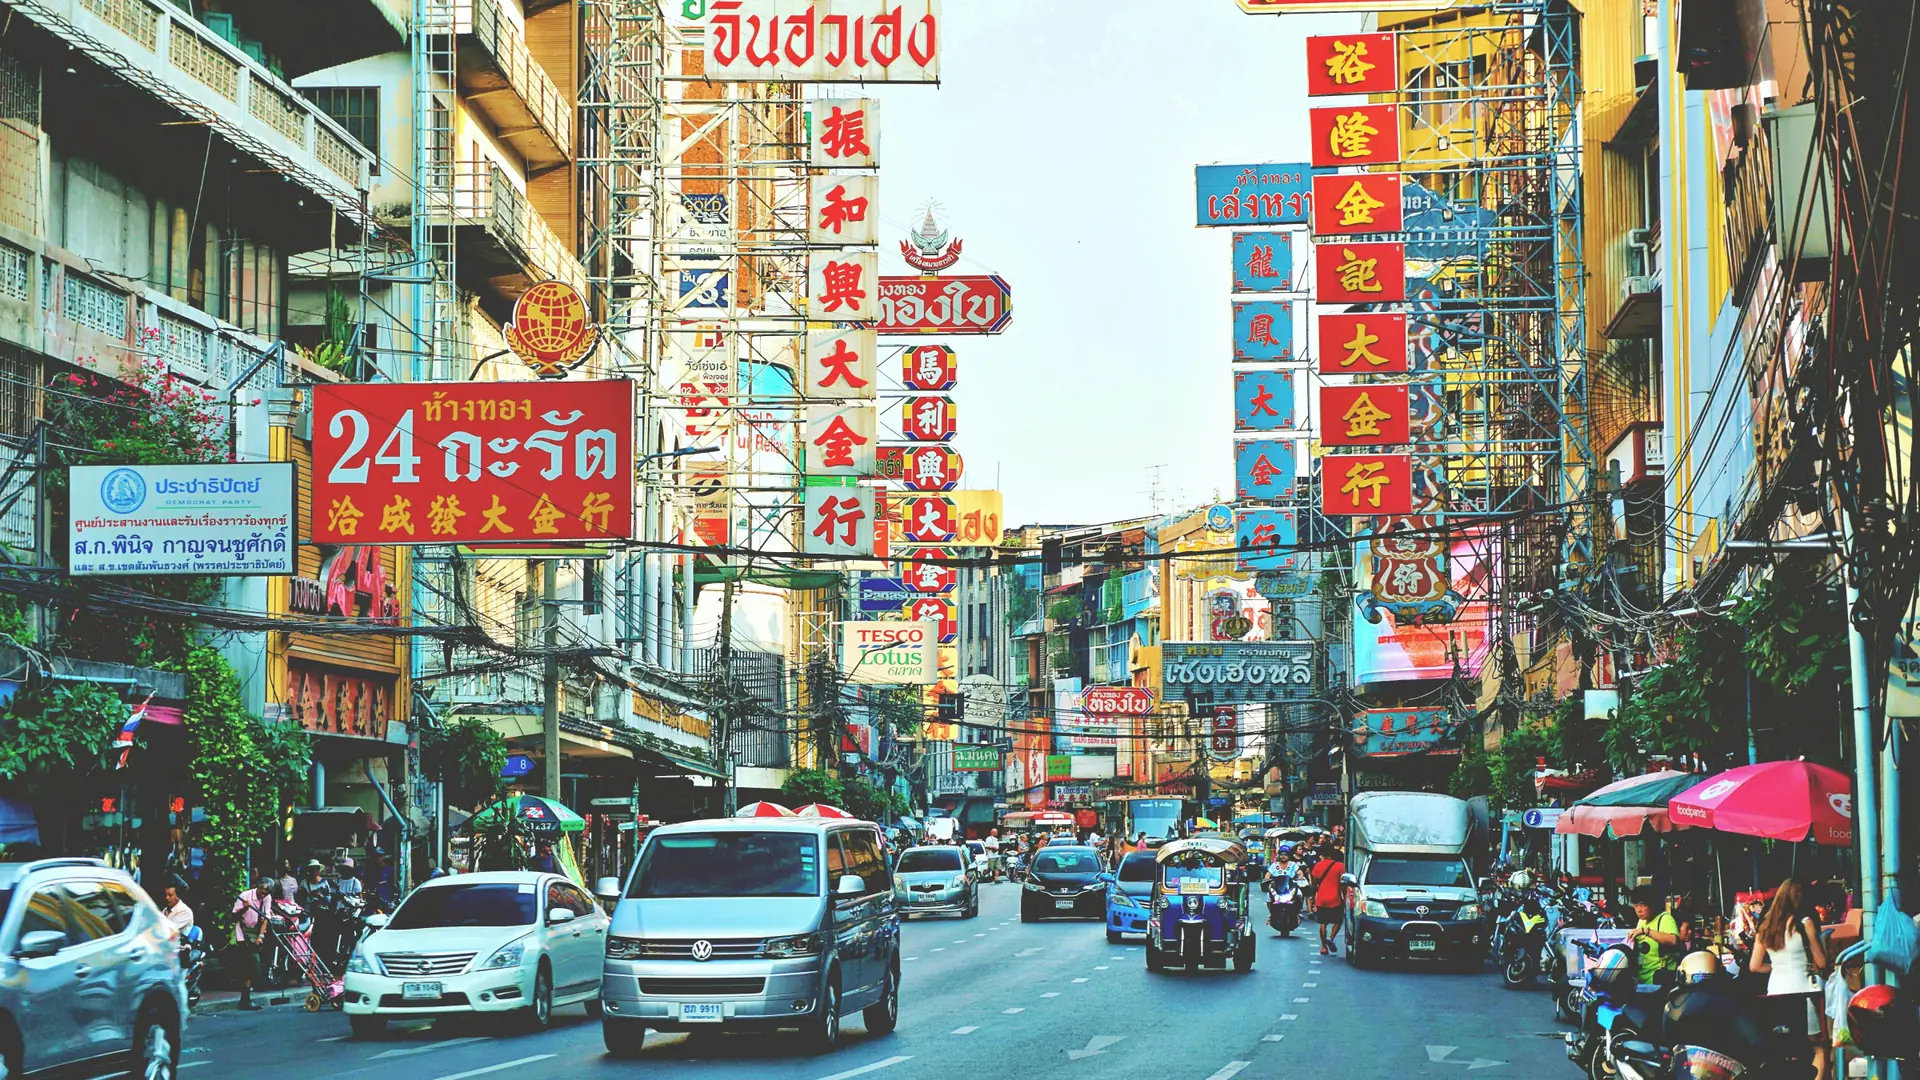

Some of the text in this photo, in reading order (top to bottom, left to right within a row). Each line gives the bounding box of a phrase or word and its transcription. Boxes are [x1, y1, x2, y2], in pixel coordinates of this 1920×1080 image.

[1237, 168, 1301, 185] ห้างทอง
[683, 200, 722, 212] GOLD
[1325, 40, 1392, 507] 裕隆金記大金行
[813, 106, 871, 547] 振和興大金行
[422, 391, 532, 422] ห้างทอง
[328, 409, 617, 484] 24 กะรัต
[155, 477, 262, 495] ประชาธิปัตย์
[75, 512, 288, 532] ศูนย์ประสานงานและรับเรื่องราวร้องทุกข์
[75, 526, 288, 561] ส.ก.พินิจ กาญจนชูศักดิ์
[74, 563, 94, 571] และ
[193, 557, 286, 571] (พรรคประชาธิปัตย์)
[857, 629, 924, 643] TESCO
[861, 649, 923, 665] Lotus
[1089, 692, 1147, 713] ทองใบ
[1677, 805, 1707, 819] foodpanda
[700, 1004, 720, 1013] 9911
